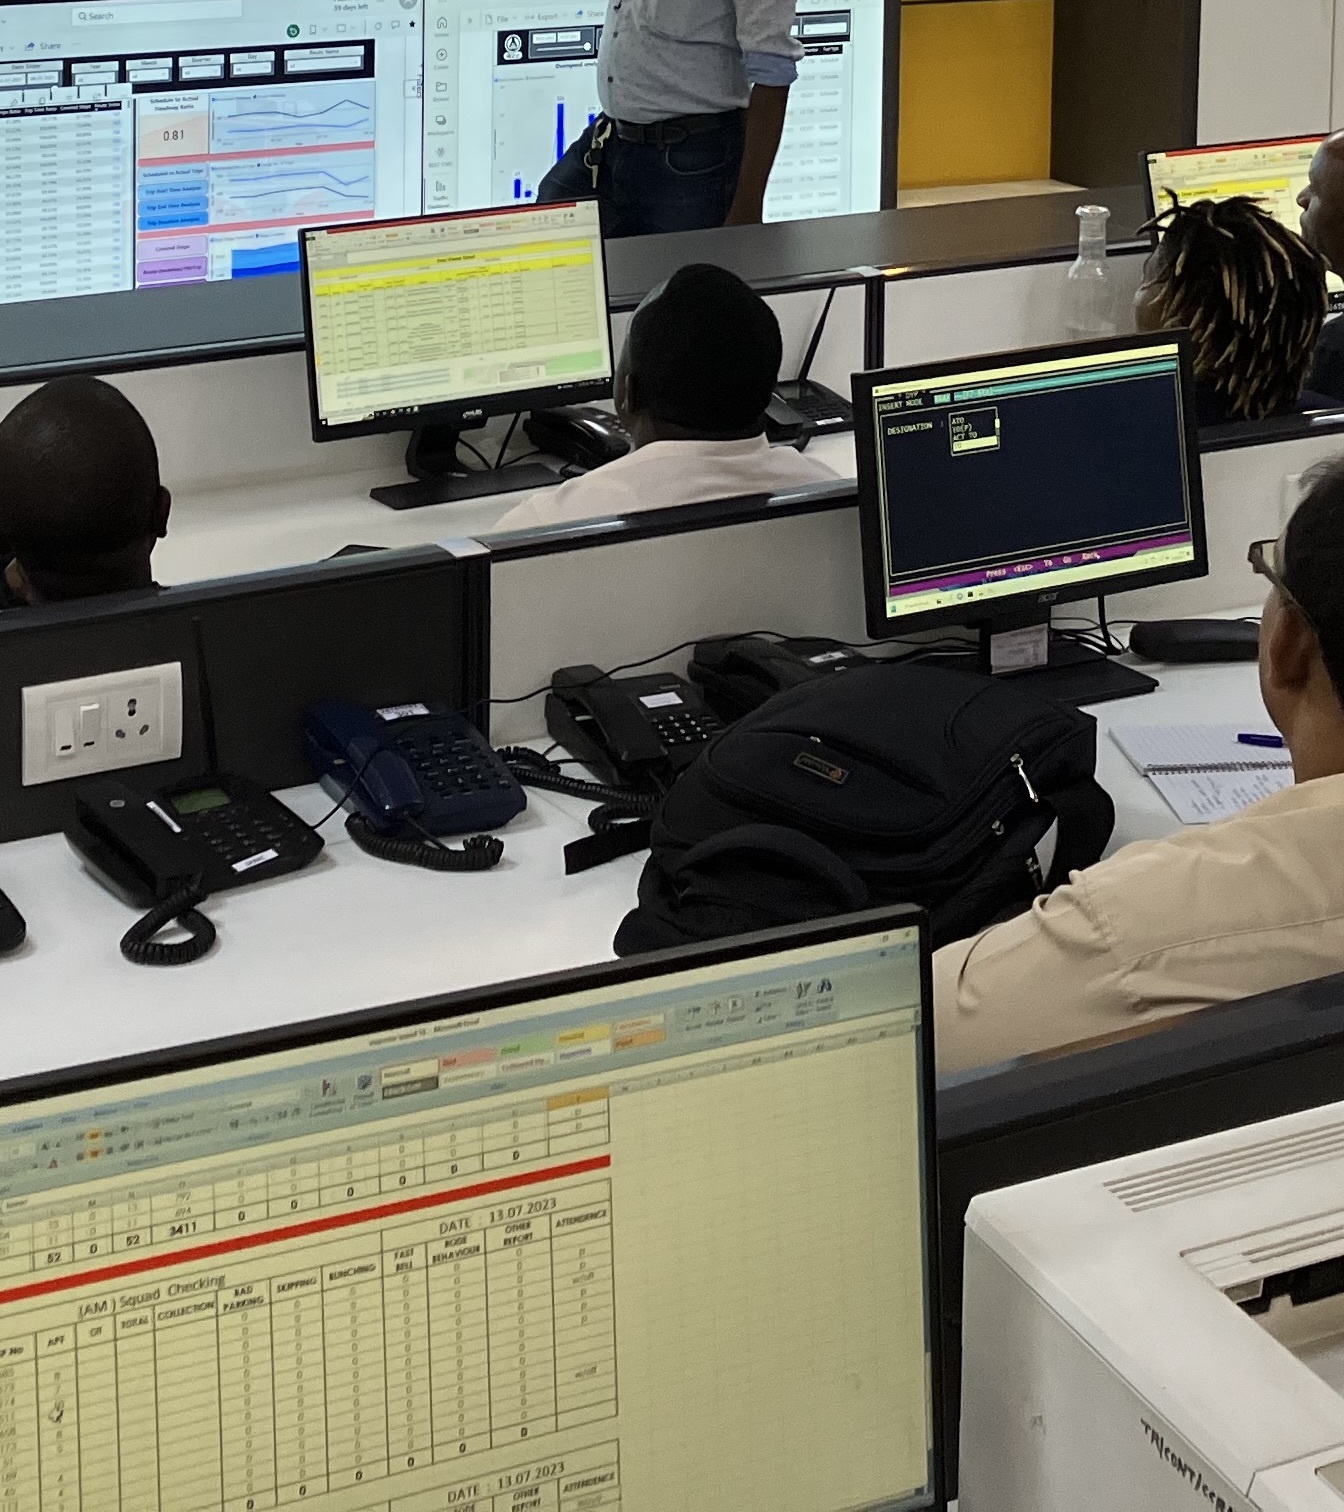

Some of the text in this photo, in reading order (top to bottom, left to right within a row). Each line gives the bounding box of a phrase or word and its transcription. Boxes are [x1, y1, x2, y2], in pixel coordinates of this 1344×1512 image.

[88, 11, 114, 21] Search
[40, 42, 62, 51] Share
[164, 130, 185, 142] 0.81
[878, 398, 923, 412] INSERT MODE
[888, 422, 933, 436] DESIGNATION
[986, 568, 1007, 578] Press
[1044, 559, 1053, 568] To
[169, 1221, 198, 1237] 3411
[504, 1221, 532, 1234] OTHER
[126, 1234, 140, 1247] 52
[503, 1232, 534, 1248] REPORT
[90, 1243, 98, 1255] 0
[394, 1248, 415, 1261] FAST
[432, 1245, 481, 1265] BEHAVIOUR
[47, 1252, 61, 1265] 52
[328, 1263, 377, 1282] BUNCHING
[276, 1276, 318, 1294] SKIPPING
[78, 1273, 227, 1319] (AM ) Squad Checking
[234, 1286, 254, 1299] BAD
[157, 1300, 216, 1321] COLLECTION
[222, 1296, 265, 1313] PARKING
[447, 1462, 566, 1504] DATE 13.07.2023
